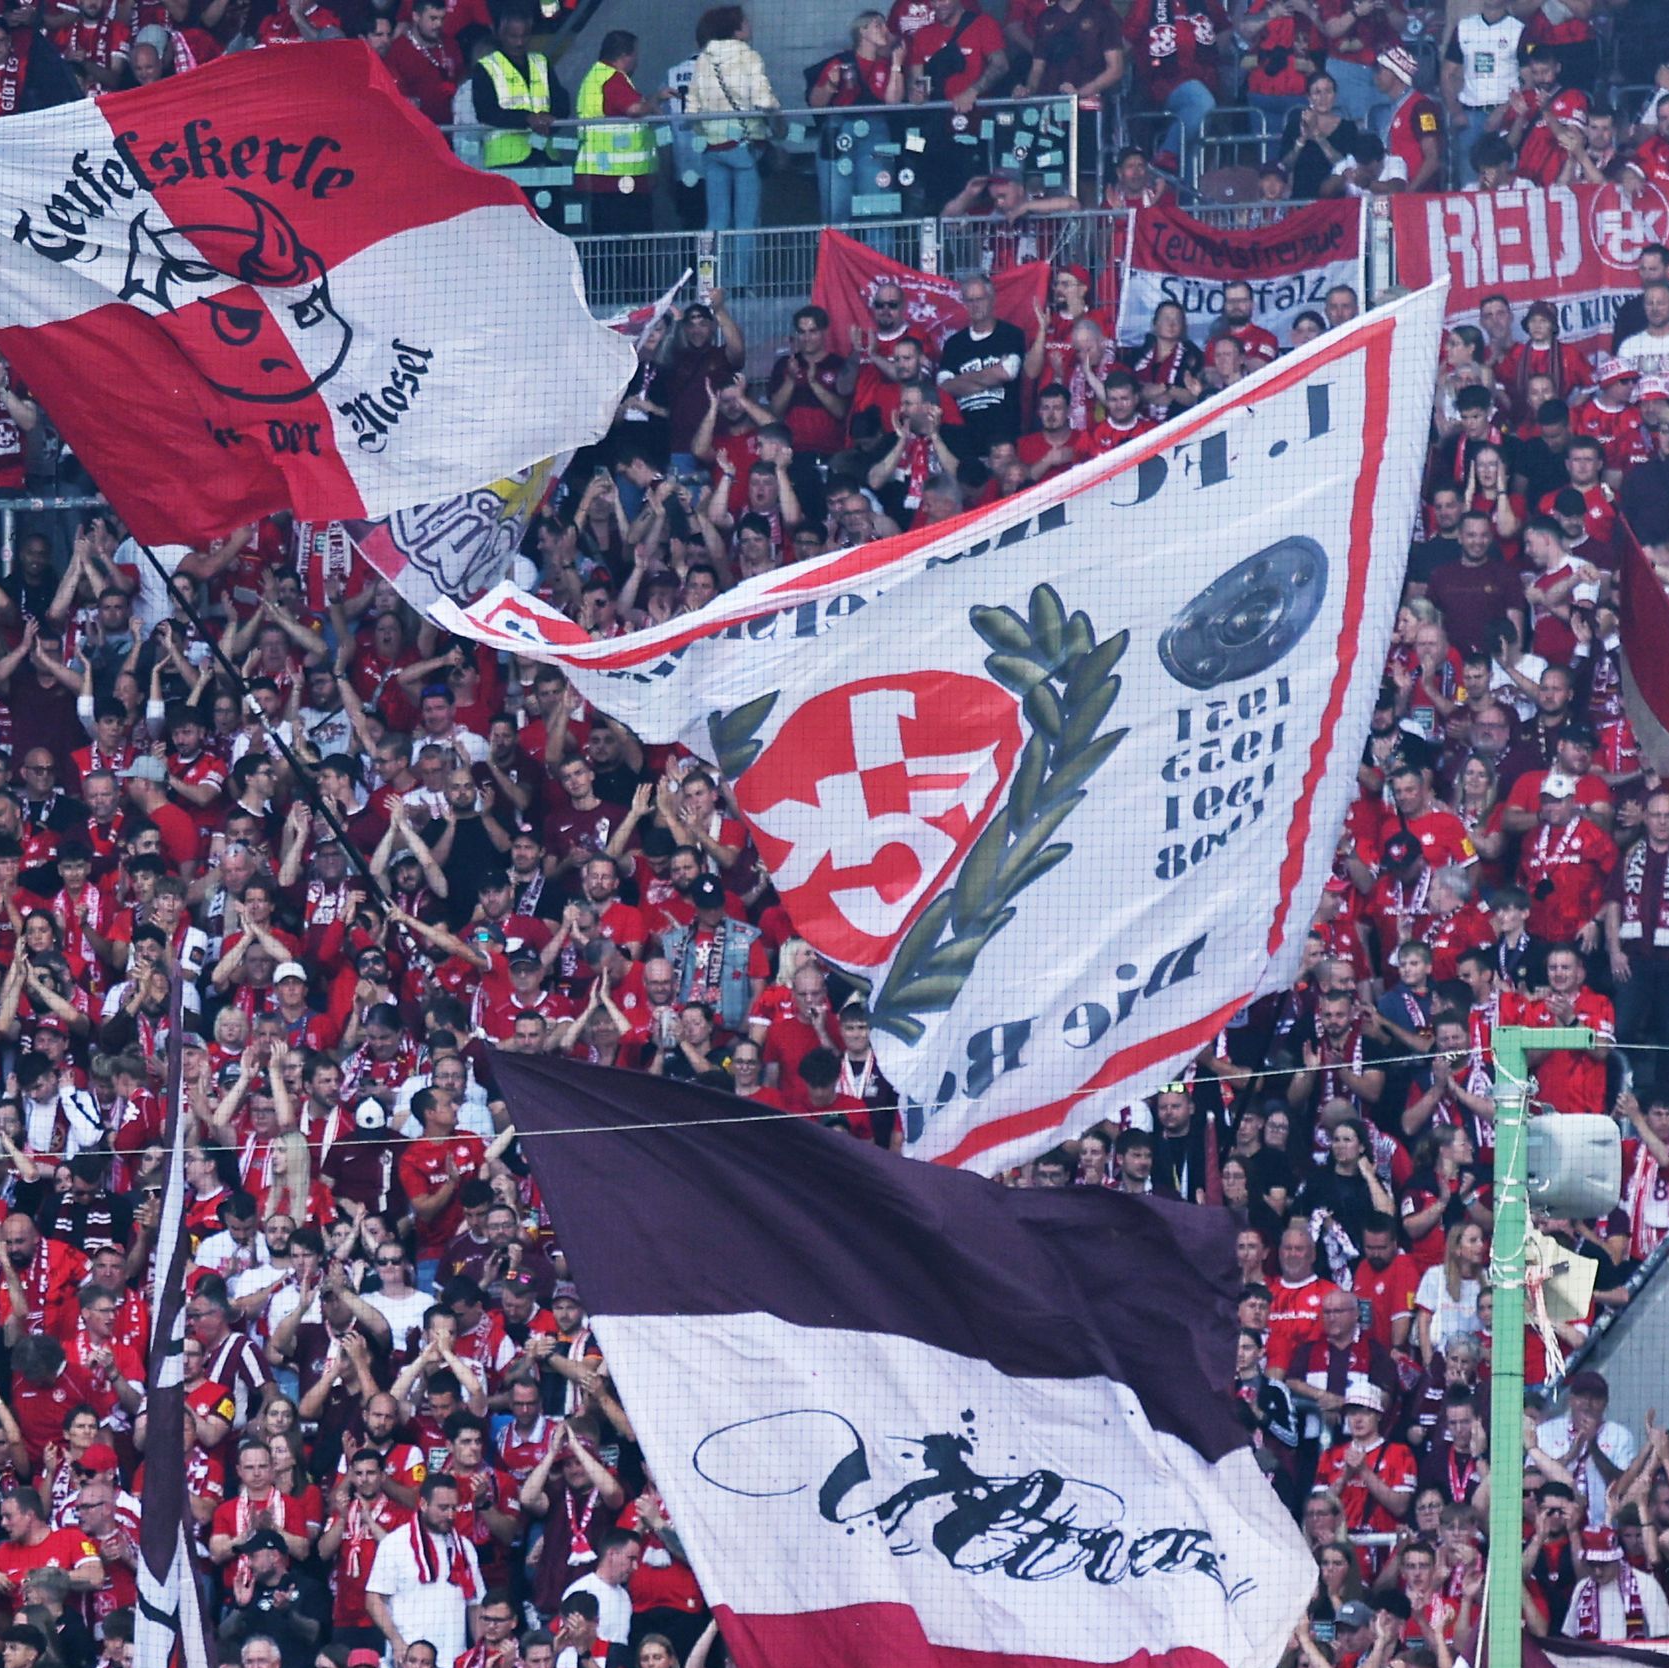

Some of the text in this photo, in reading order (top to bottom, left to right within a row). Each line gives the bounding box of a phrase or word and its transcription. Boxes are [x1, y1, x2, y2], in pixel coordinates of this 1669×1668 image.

[12, 119, 356, 263] Teufelskerle
[1426, 184, 1584, 287] RED
[1160, 275, 1329, 318] Südfalz
[356, 338, 436, 454] Mosel
[1266, 1310, 1317, 1322] OVOLINE
